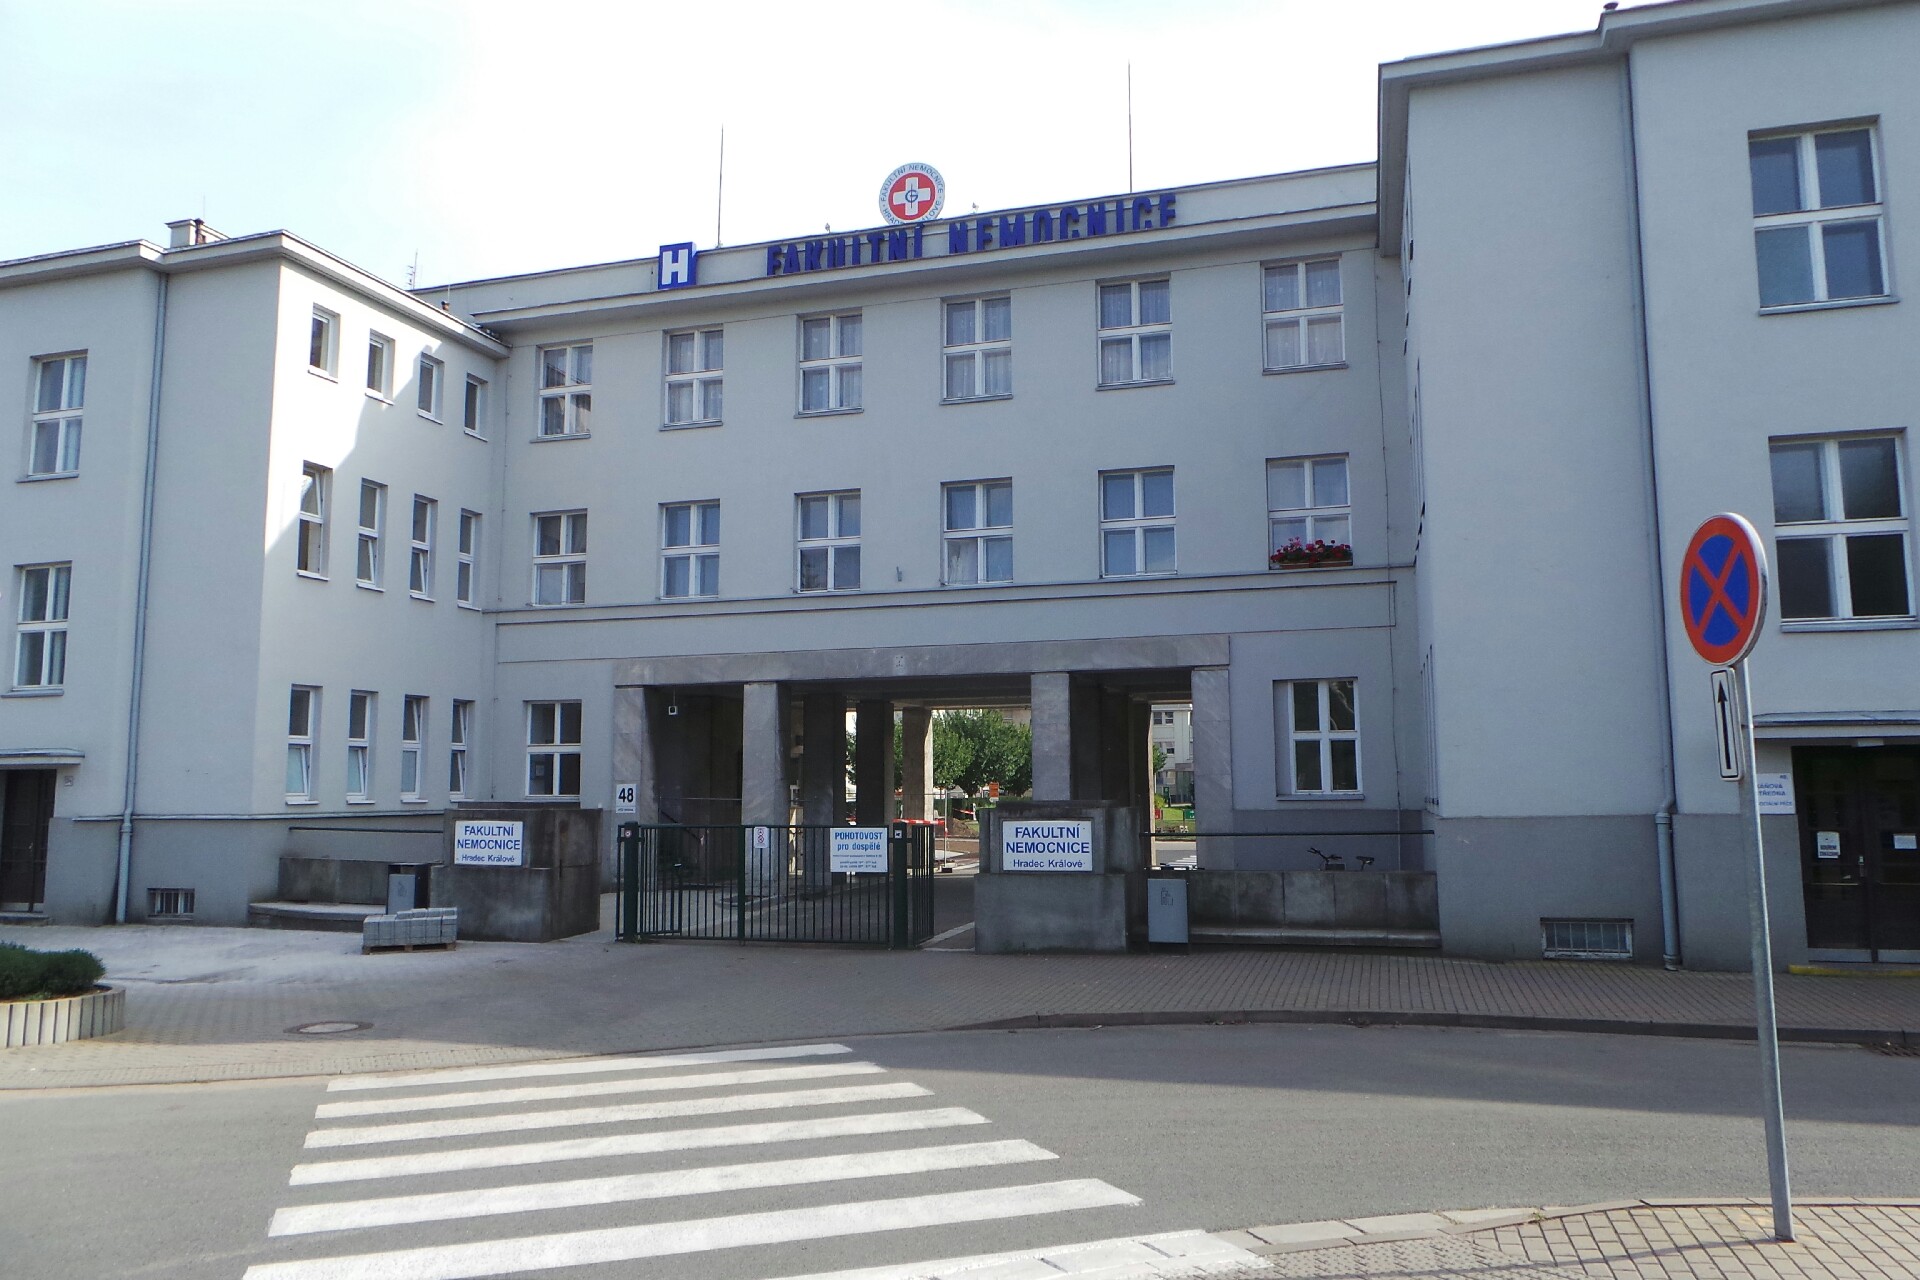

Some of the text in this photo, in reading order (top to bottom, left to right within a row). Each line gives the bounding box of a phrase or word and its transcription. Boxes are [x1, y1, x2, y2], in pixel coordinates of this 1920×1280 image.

[948, 193, 1177, 255] NEMOCNICE
[661, 249, 689, 285] H
[618, 787, 634, 803] 48
[464, 824, 515, 837] FAKULTNÍ
[834, 831, 883, 841] POHOTOVOST
[1015, 823, 1081, 839] FAKULTNÍ
[457, 839, 521, 850] NEMOCNICE
[837, 842, 881, 852] pro dospělé
[1006, 841, 1090, 854] NEMOCNICE
[461, 854, 515, 863] Hradec Králové
[1013, 859, 1083, 868] Hradec Králové
